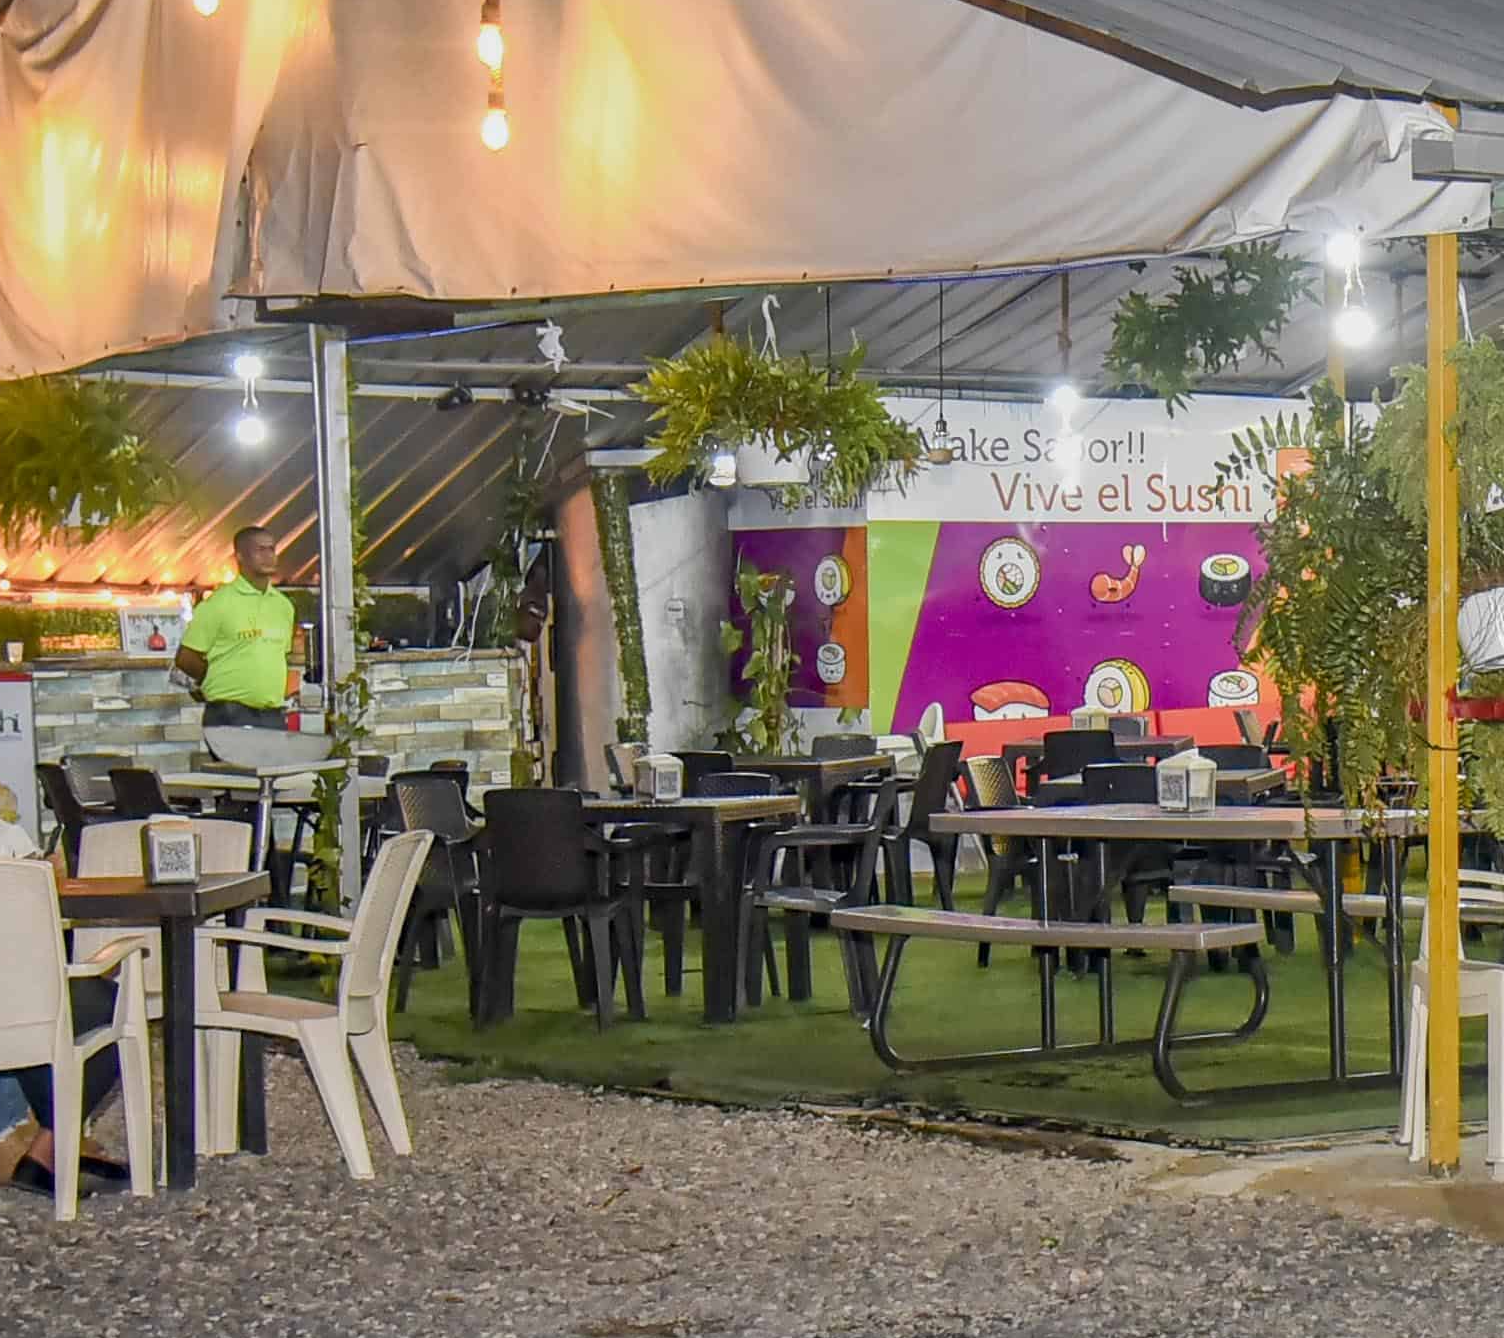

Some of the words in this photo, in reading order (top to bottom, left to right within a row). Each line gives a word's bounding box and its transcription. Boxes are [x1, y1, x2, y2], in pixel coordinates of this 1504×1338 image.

[1023, 428, 1145, 464] Saor!!
[990, 472, 1083, 512] Vive
[1098, 474, 1132, 512] el
